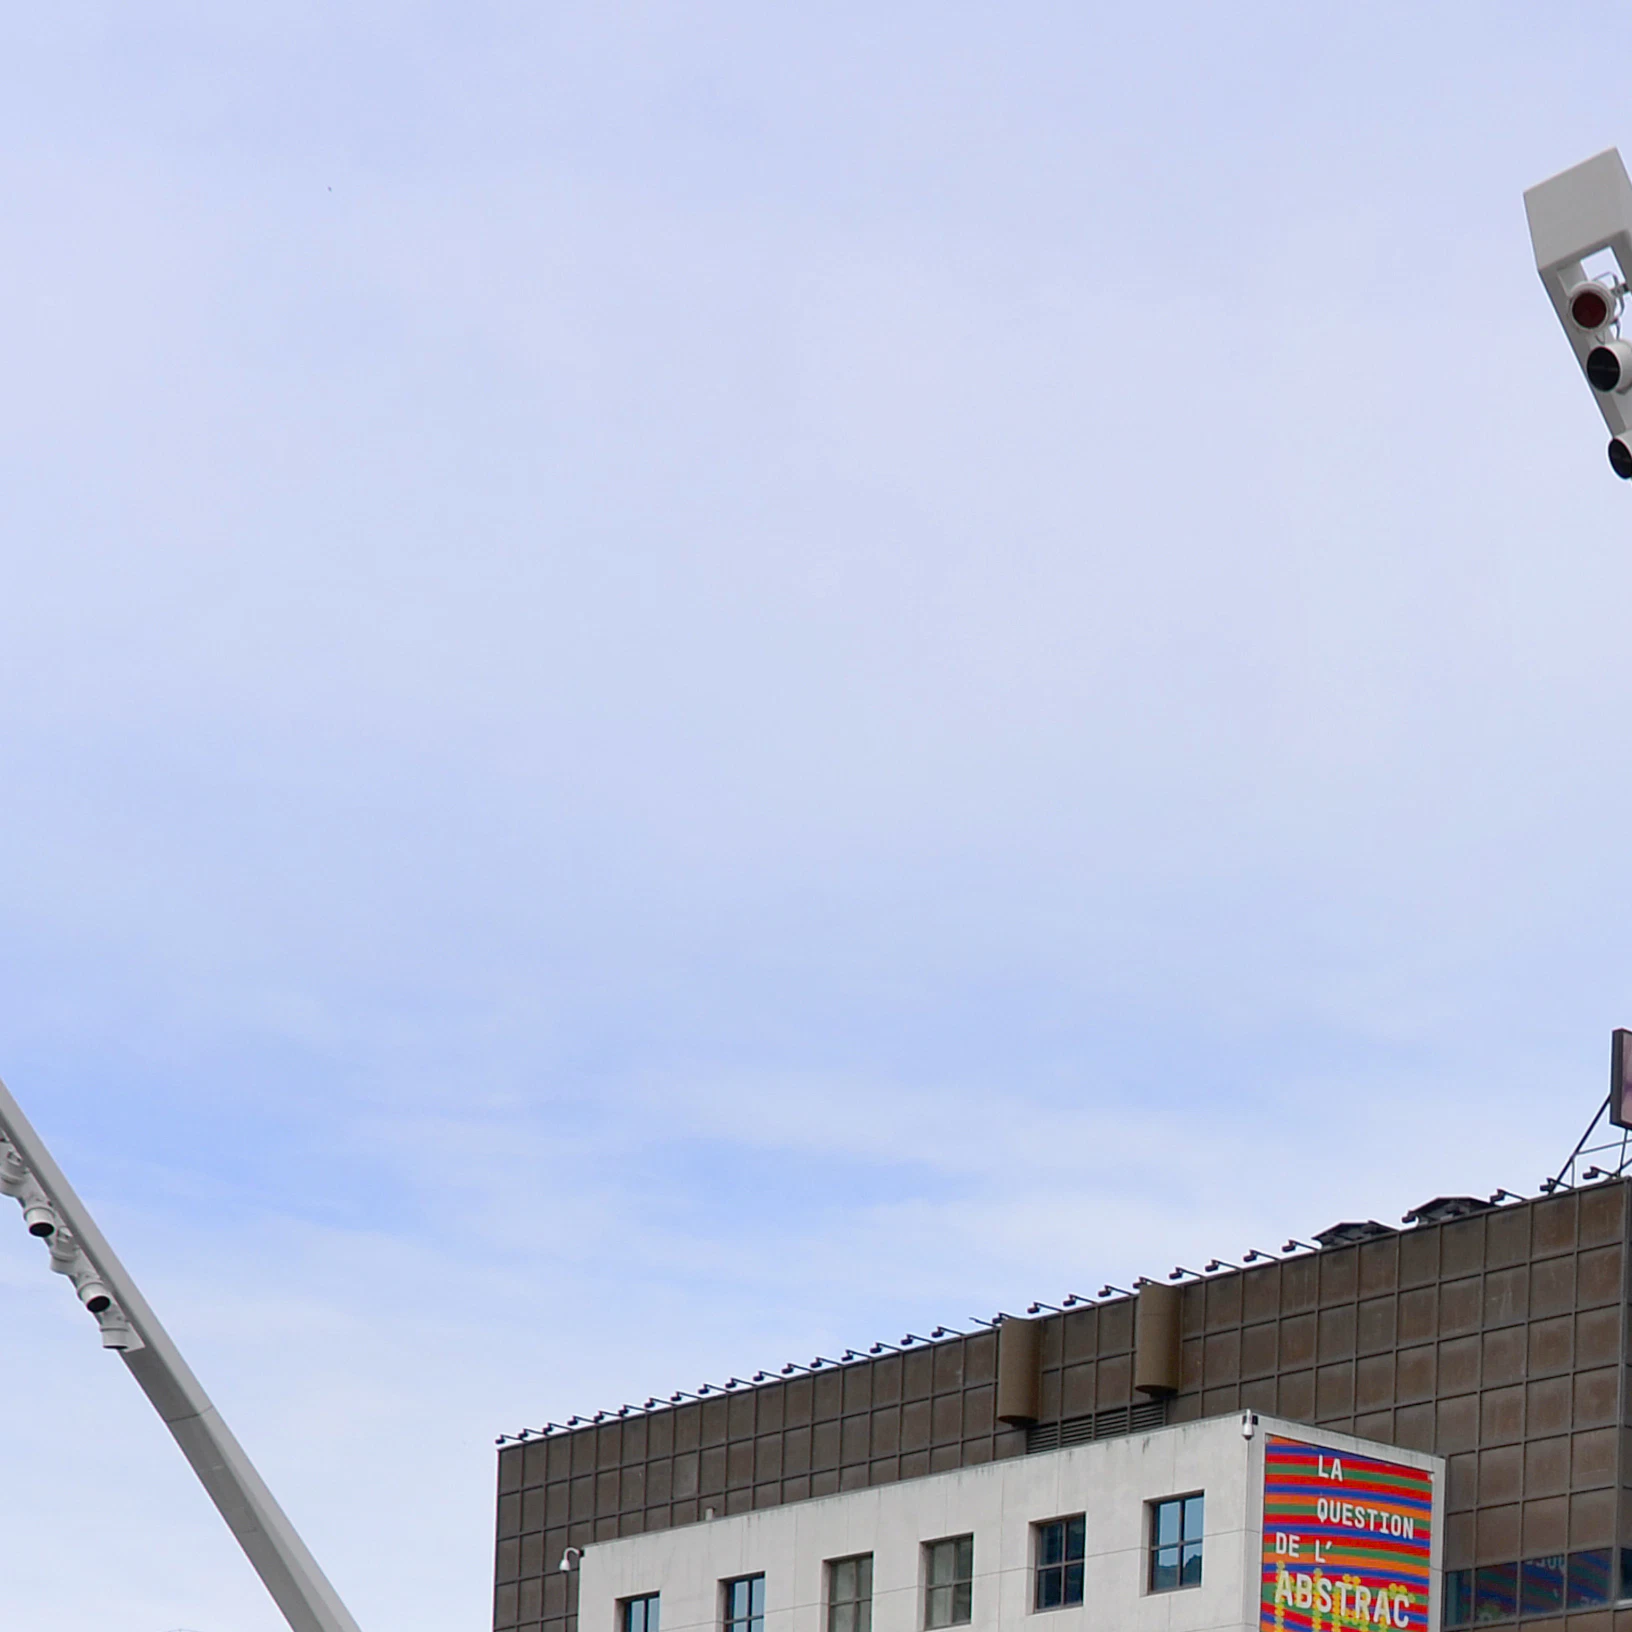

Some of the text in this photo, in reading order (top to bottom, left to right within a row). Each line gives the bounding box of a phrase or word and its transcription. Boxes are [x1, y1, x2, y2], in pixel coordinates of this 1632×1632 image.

[1318, 1454, 1343, 1482] LA
[1317, 1498, 1414, 1540] QUESTION
[1275, 1531, 1300, 1558] DE
[1275, 1570, 1410, 1628] ABSTRAC
